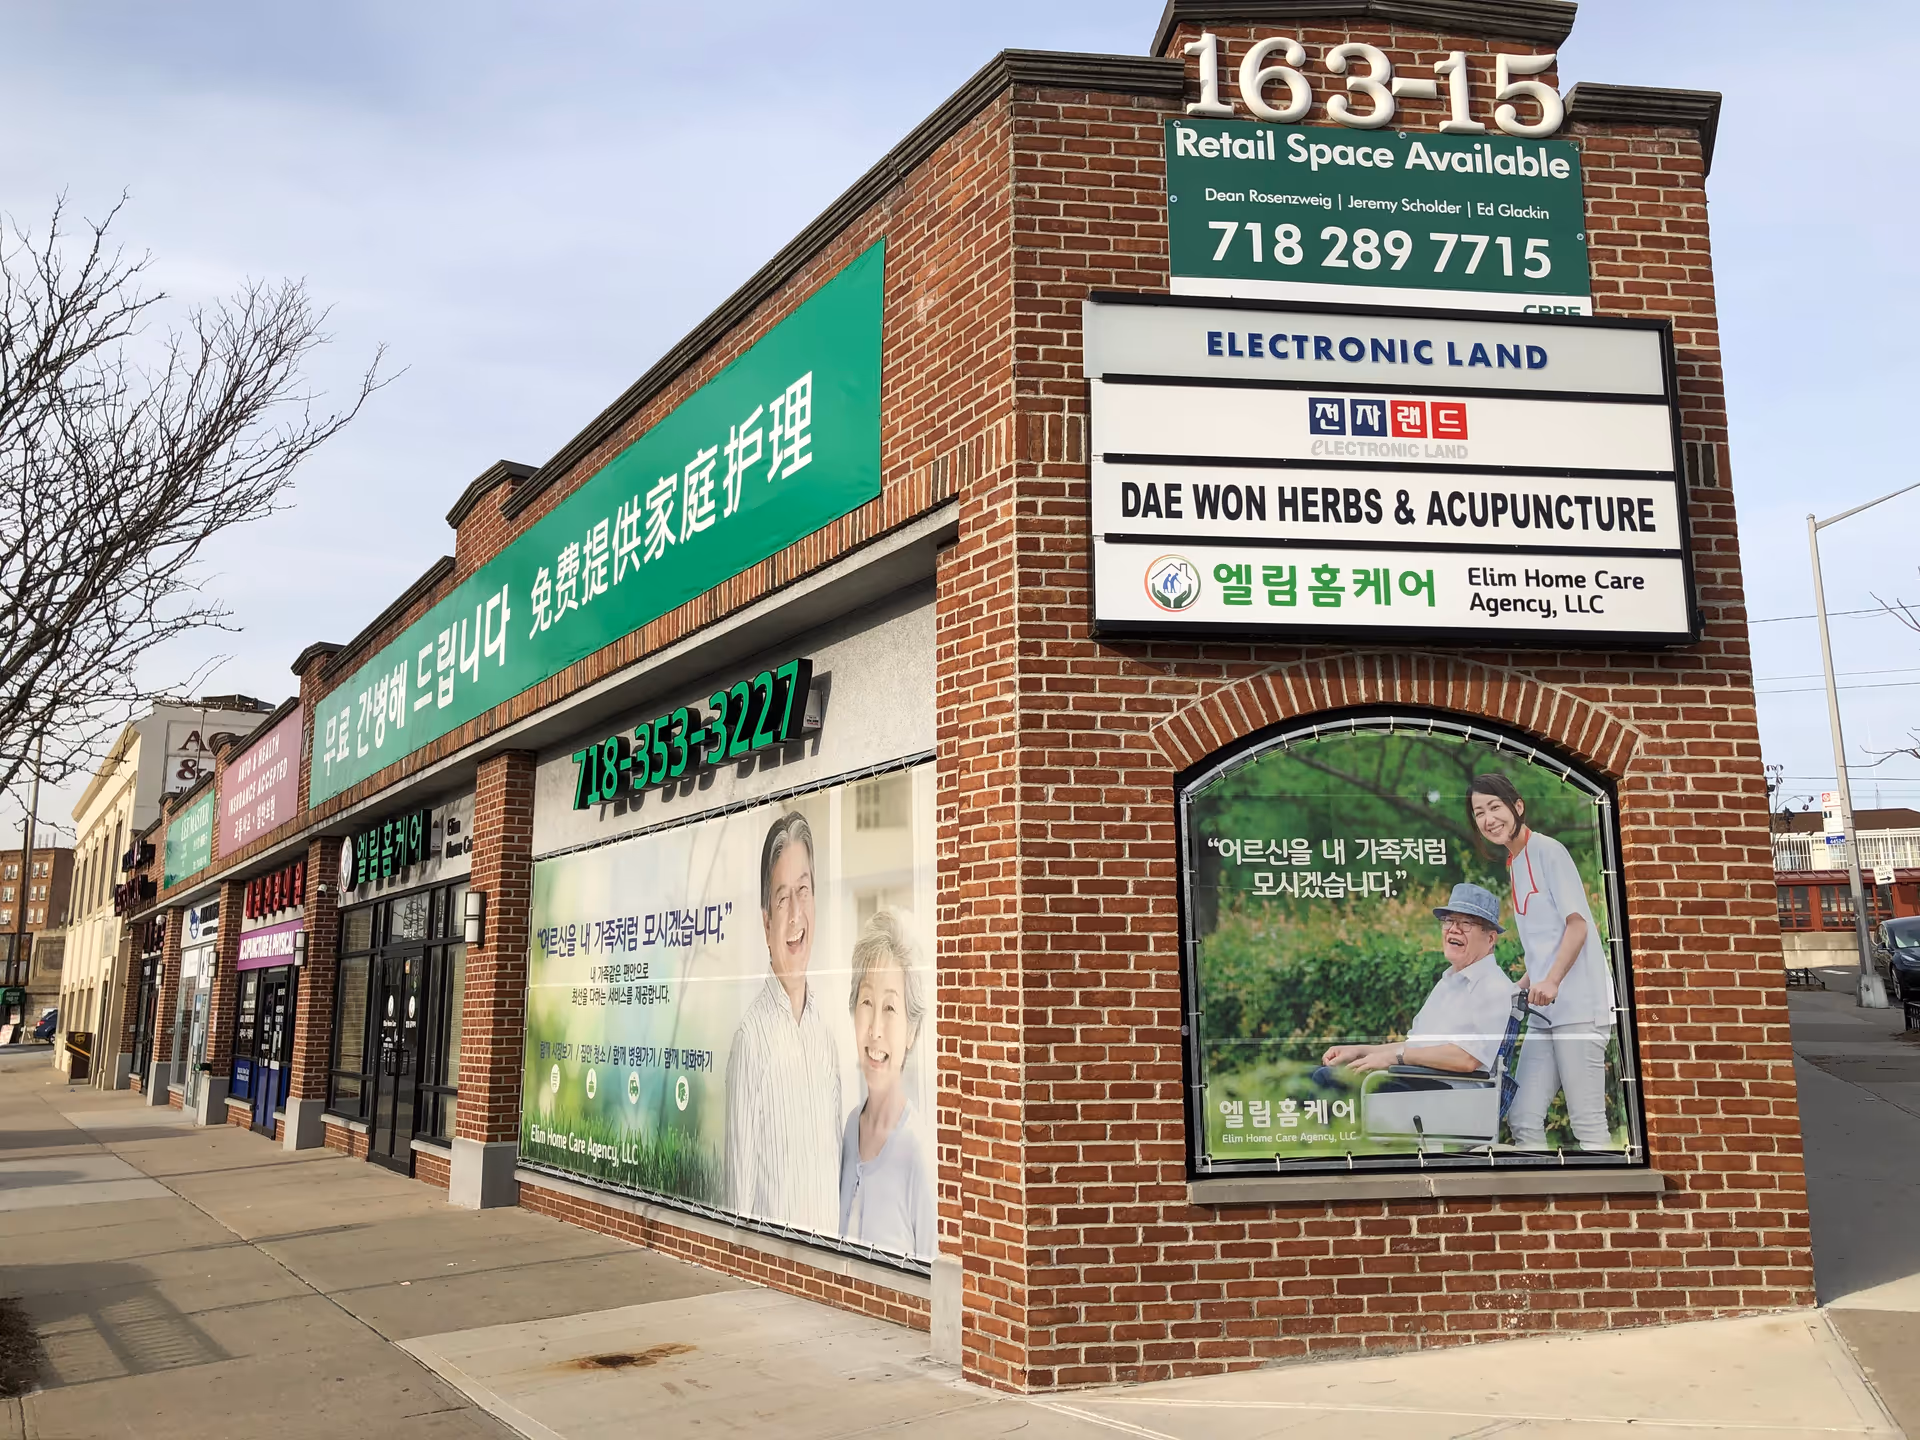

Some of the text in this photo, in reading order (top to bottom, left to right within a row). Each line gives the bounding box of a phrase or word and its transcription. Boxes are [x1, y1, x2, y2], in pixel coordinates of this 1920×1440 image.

[1183, 33, 1565, 138] 163-15
[1175, 127, 1571, 180] Retail Space Available
[1204, 187, 1245, 203] Dean
[1248, 189, 1333, 210] Rosenzweig
[1347, 195, 1398, 214] Jeremy
[1401, 197, 1462, 216] Scholder
[1477, 202, 1494, 217] Ed
[1497, 203, 1550, 220] Glackin
[1208, 221, 1552, 279] 718 289 7715
[1206, 330, 1549, 371] ELECTRONIC LAND
[1311, 399, 1466, 438] 전자랜드
[1424, 443, 1468, 460] LAND
[1121, 481, 1656, 533] DAE WON HERBS & ACUPUNCTURE
[324, 371, 813, 777] 무료 간병해 드립니다 免费提供家庭护理
[1212, 562, 1436, 608] 엘림홈케어
[1468, 567, 1645, 591] Elim Home Care
[1470, 593, 1604, 618] Agency, LLC
[573, 658, 804, 811] 718-353-3227
[257, 757, 288, 797] ACCEPTED
[357, 809, 424, 884] 엘림홈케어
[1321, 838, 1346, 866] 내
[1355, 838, 1447, 866] 가족처럼
[580, 922, 591, 955] 내
[594, 915, 639, 954] 가족처럼
[607, 985, 634, 1005] 서비스를
[1219, 1098, 1356, 1129] 엘림홈케어
[531, 1124, 639, 1168] Elim Home Care Agency, LLC
[1222, 1131, 1357, 1144] Elim Home Care Agency, LLC
